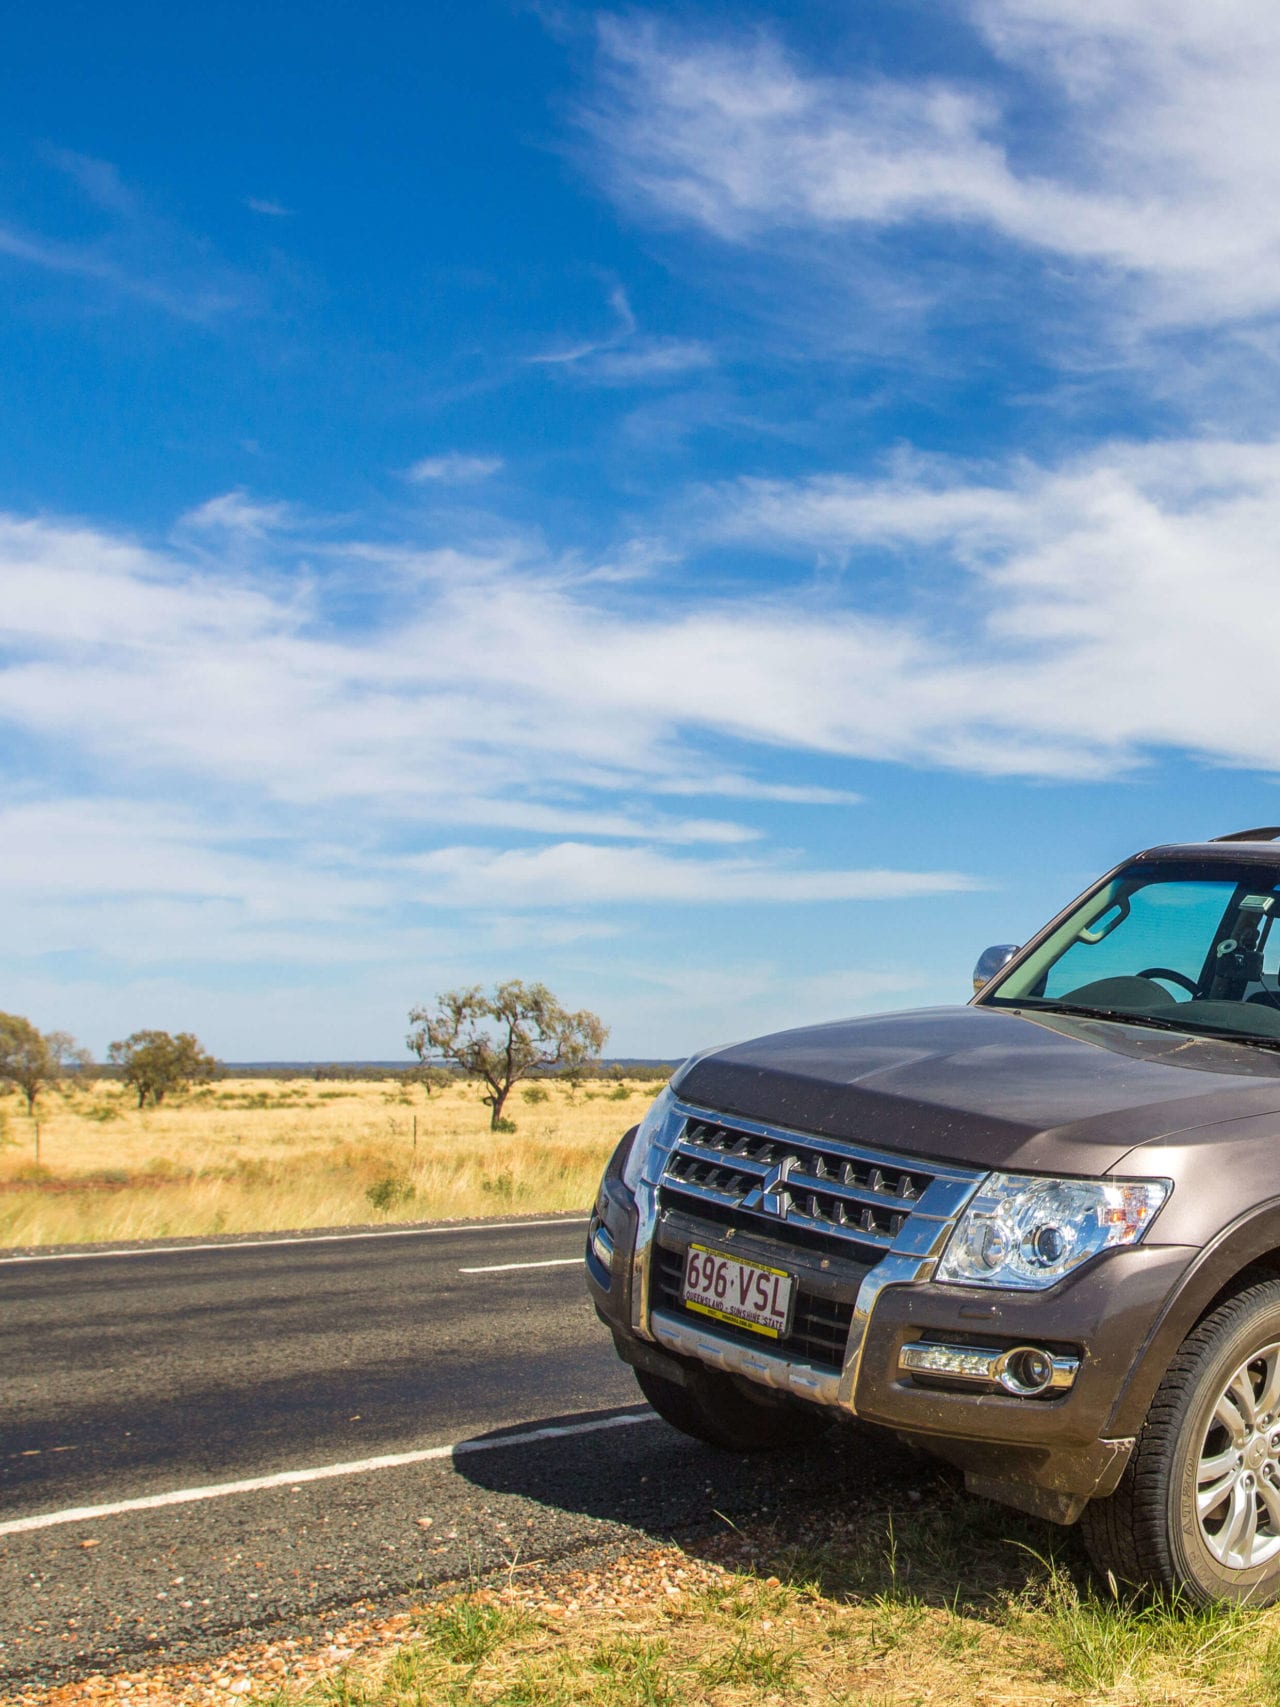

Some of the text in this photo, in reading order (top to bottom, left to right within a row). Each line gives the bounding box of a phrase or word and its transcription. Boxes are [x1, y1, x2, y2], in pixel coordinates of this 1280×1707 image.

[686, 1291, 724, 1311] QUEENSLAND
[730, 1306, 761, 1324] SUNSHINE
[761, 1316, 784, 1330] STATE
[687, 1253, 727, 1298] 696
[739, 1267, 785, 1318] VSL
